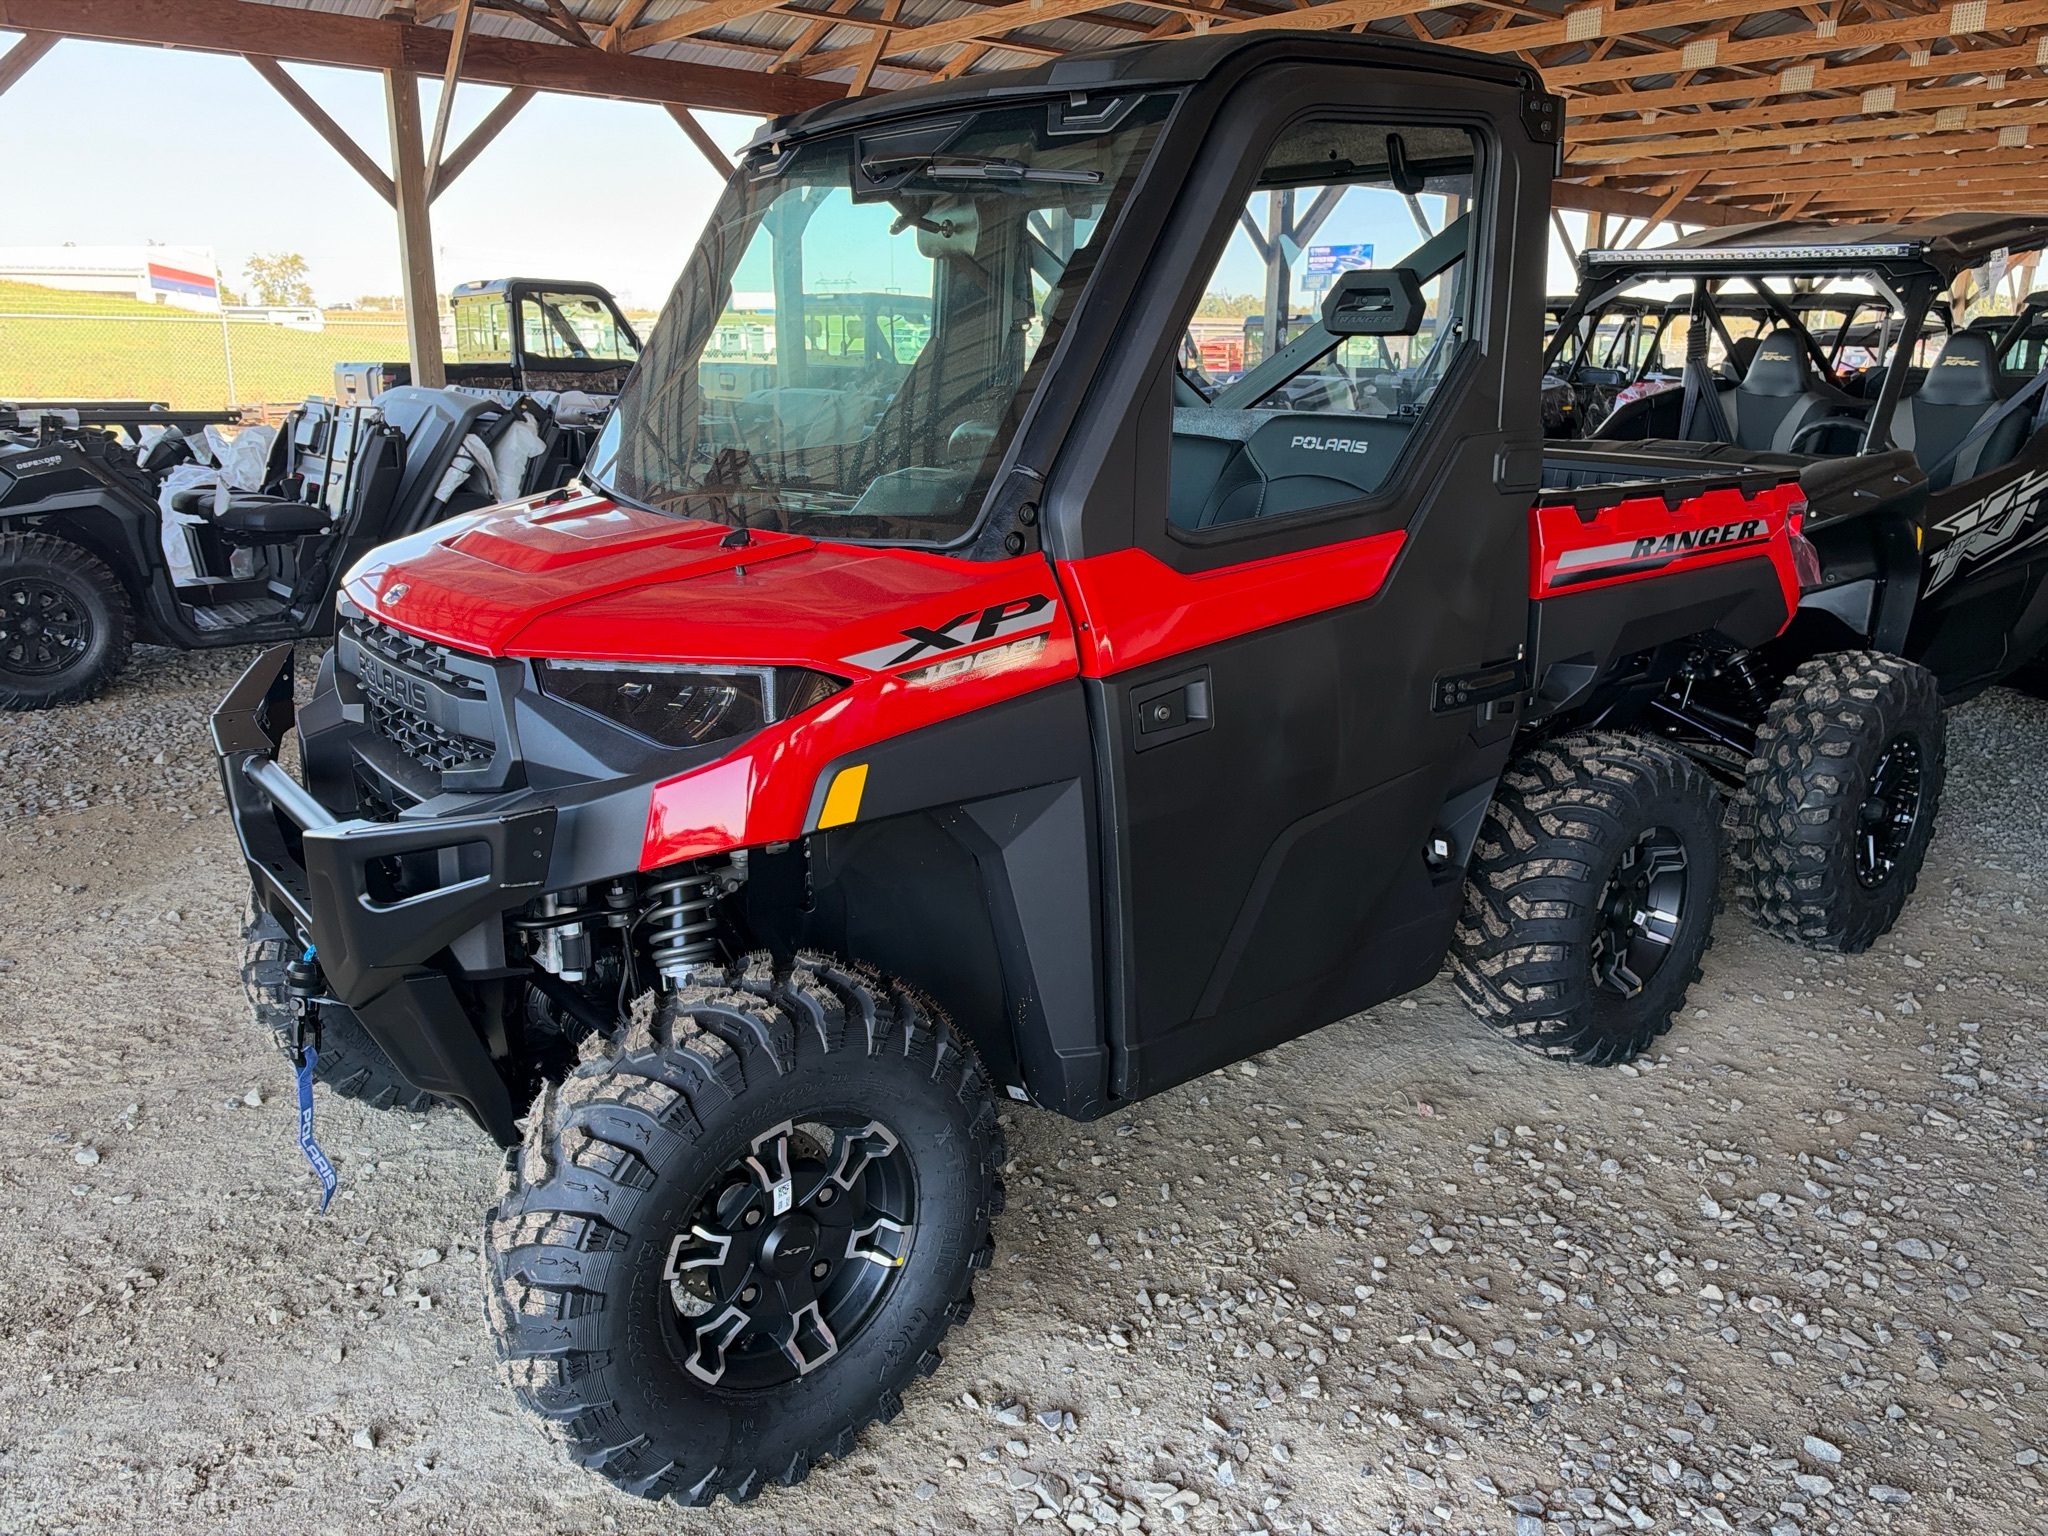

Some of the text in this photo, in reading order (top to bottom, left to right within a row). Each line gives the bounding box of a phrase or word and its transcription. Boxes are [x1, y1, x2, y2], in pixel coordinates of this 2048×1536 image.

[1338, 315, 1393, 324] RANGER
[15, 454, 62, 470] DEFENDER
[1290, 436, 1369, 454] POLARIS
[1630, 519, 1760, 560] RANGER
[880, 593, 1051, 669] XP
[923, 635, 1042, 684] 1000
[359, 652, 428, 713] POLARIS
[302, 1106, 337, 1190] POLARIS
[778, 1245, 811, 1257] XP
